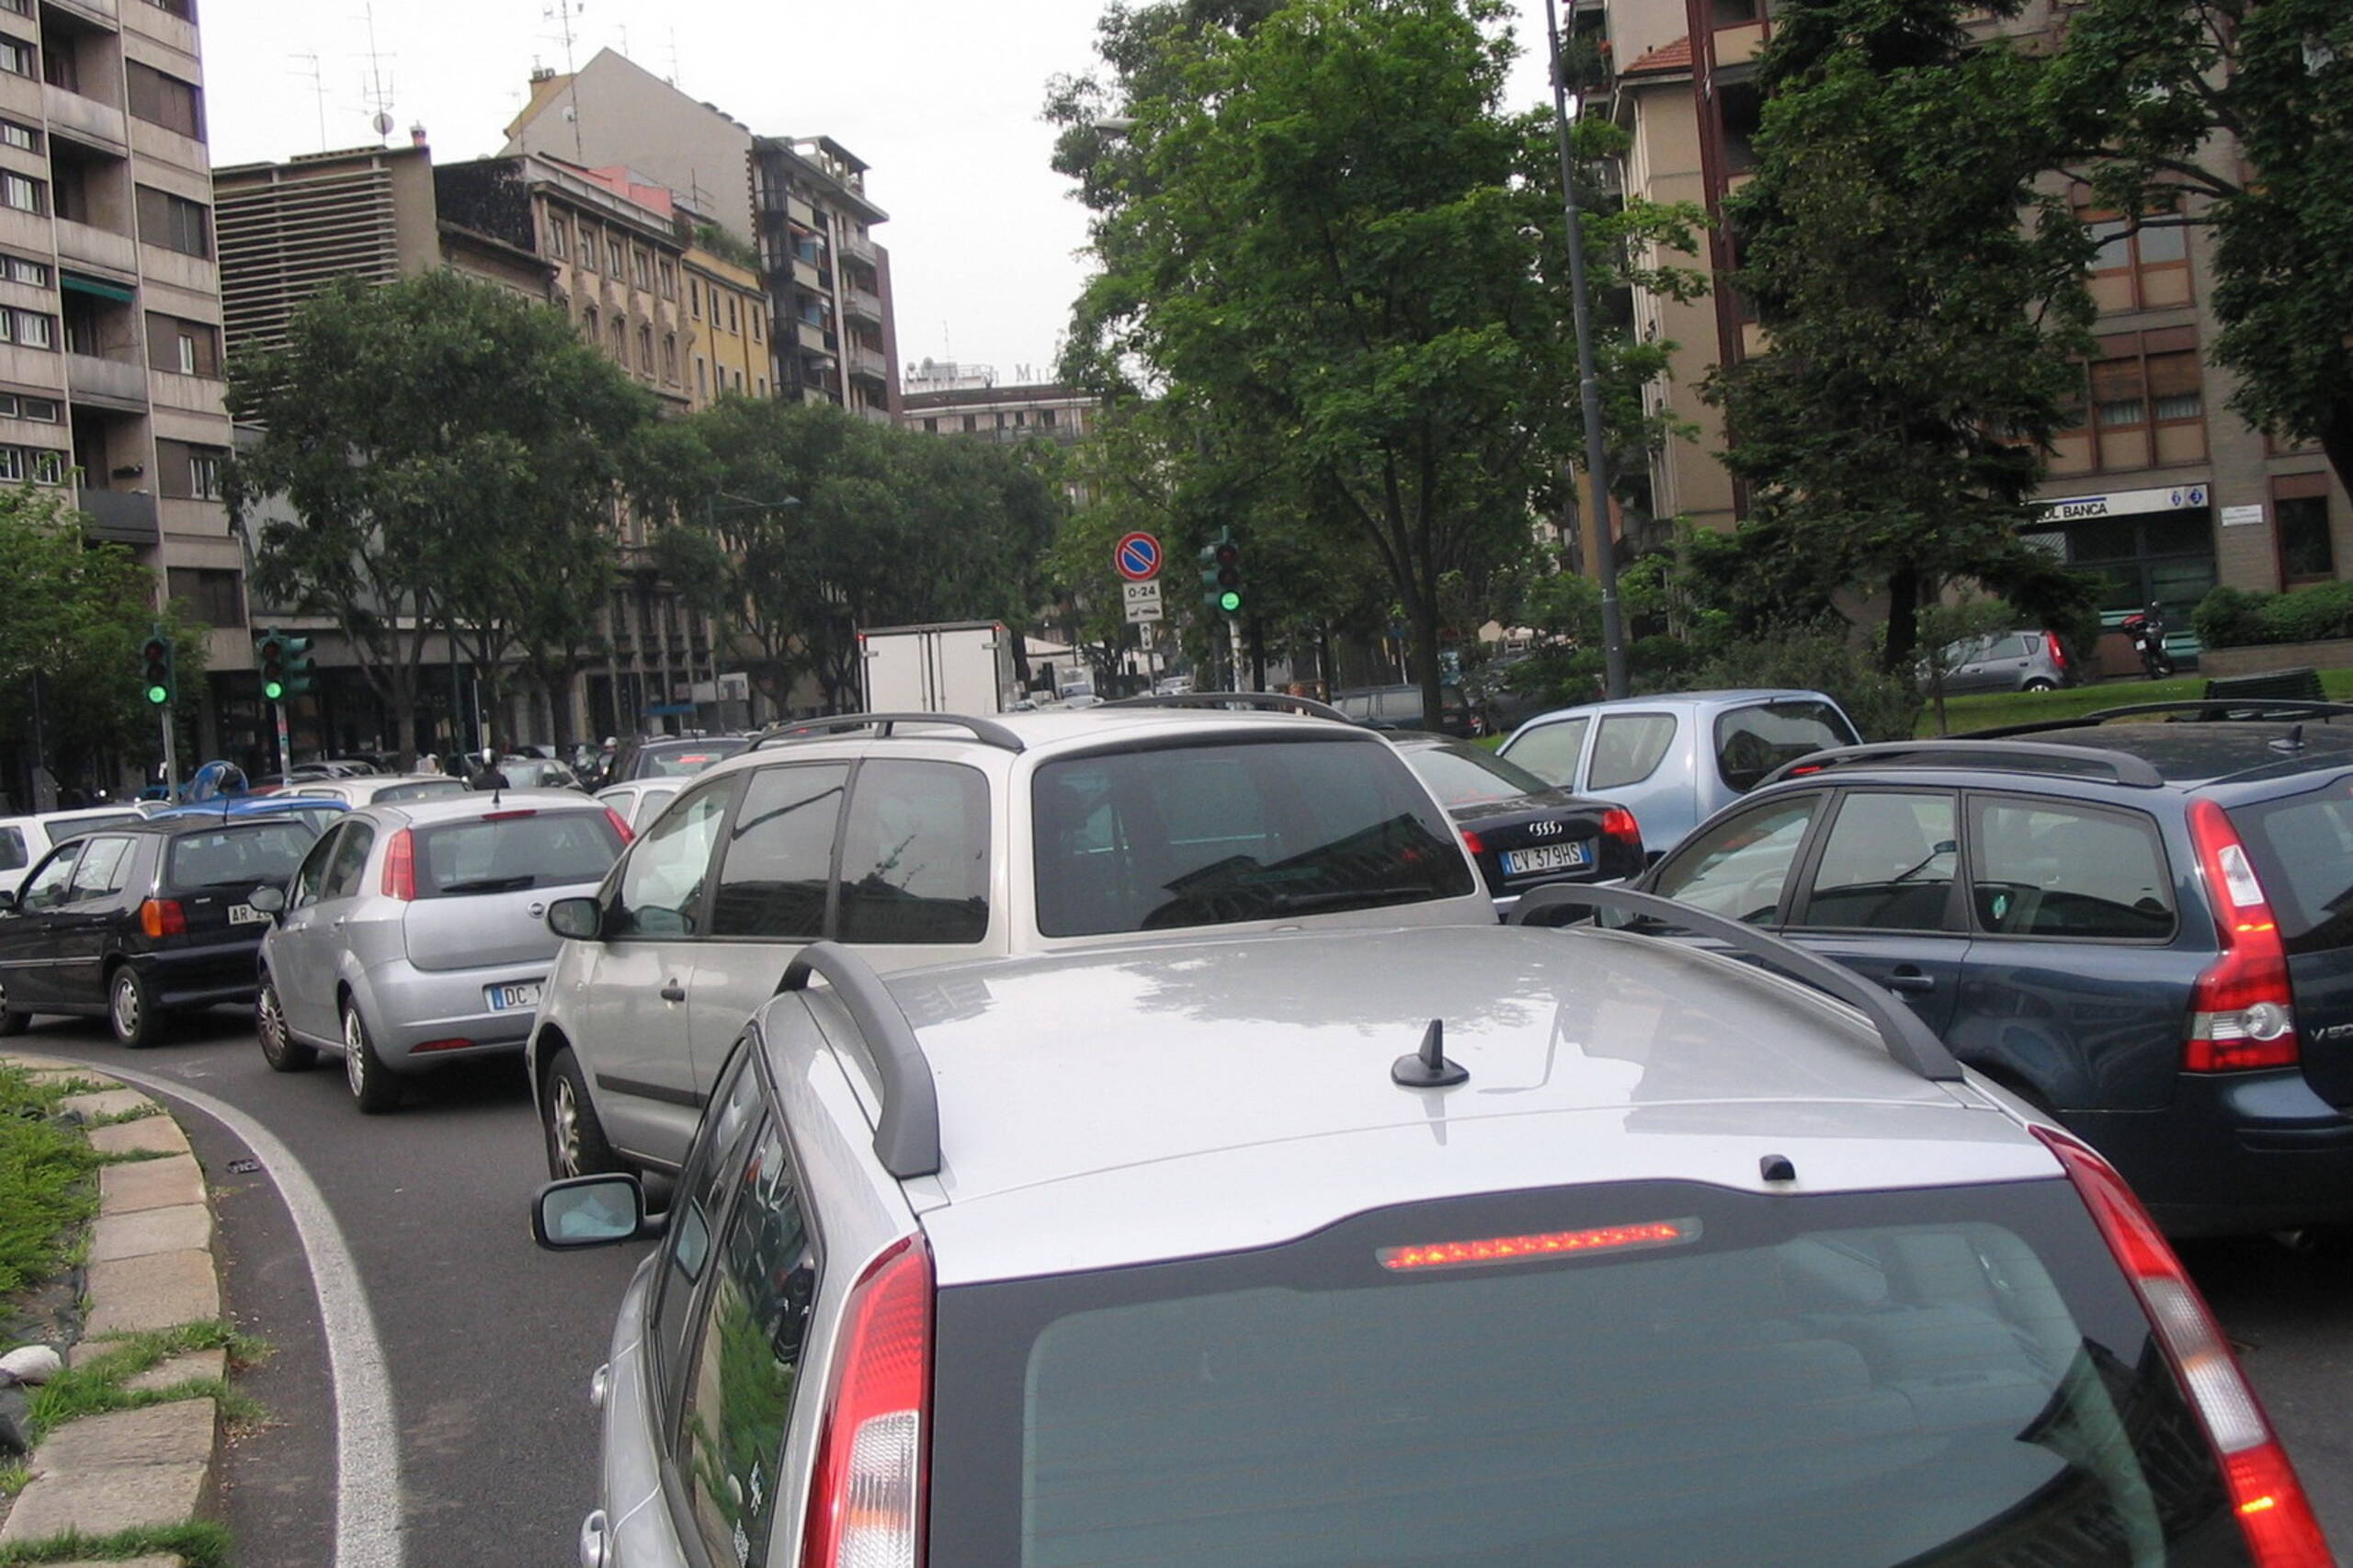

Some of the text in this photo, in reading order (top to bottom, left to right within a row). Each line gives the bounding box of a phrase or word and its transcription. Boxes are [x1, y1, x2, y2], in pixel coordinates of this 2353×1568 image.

[2063, 503, 2108, 517] BANCA
[1128, 585, 1156, 597] 0-24
[1511, 843, 1580, 871] CV 379HS
[505, 986, 527, 1006] DC
